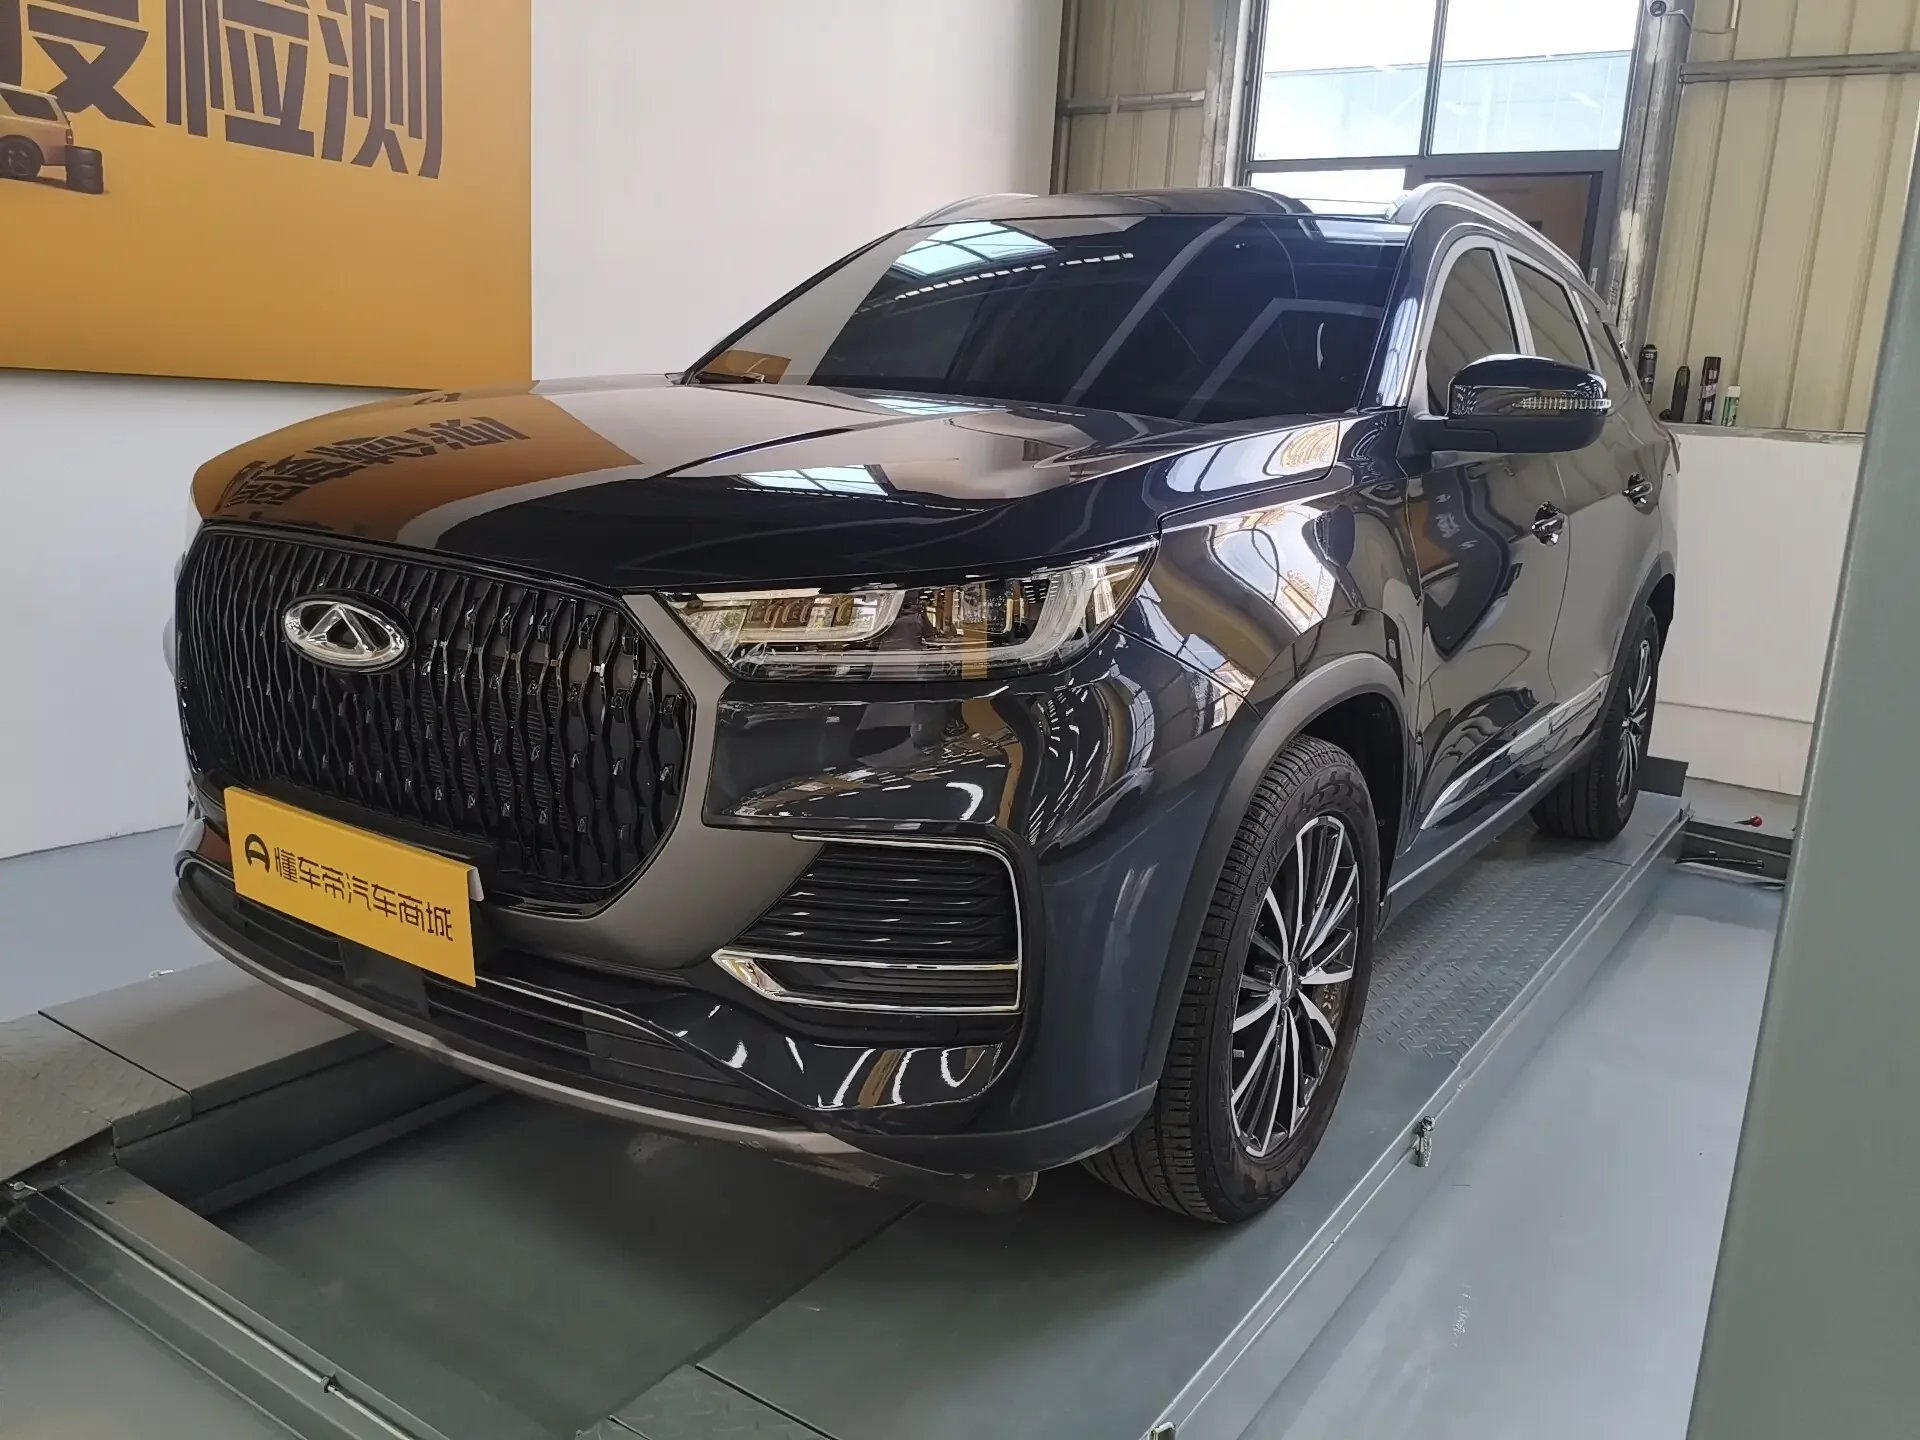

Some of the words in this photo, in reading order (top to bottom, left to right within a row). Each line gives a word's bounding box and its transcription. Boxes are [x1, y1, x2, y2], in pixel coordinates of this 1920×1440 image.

[274, 847, 454, 942] 懂车帝汽车商城
